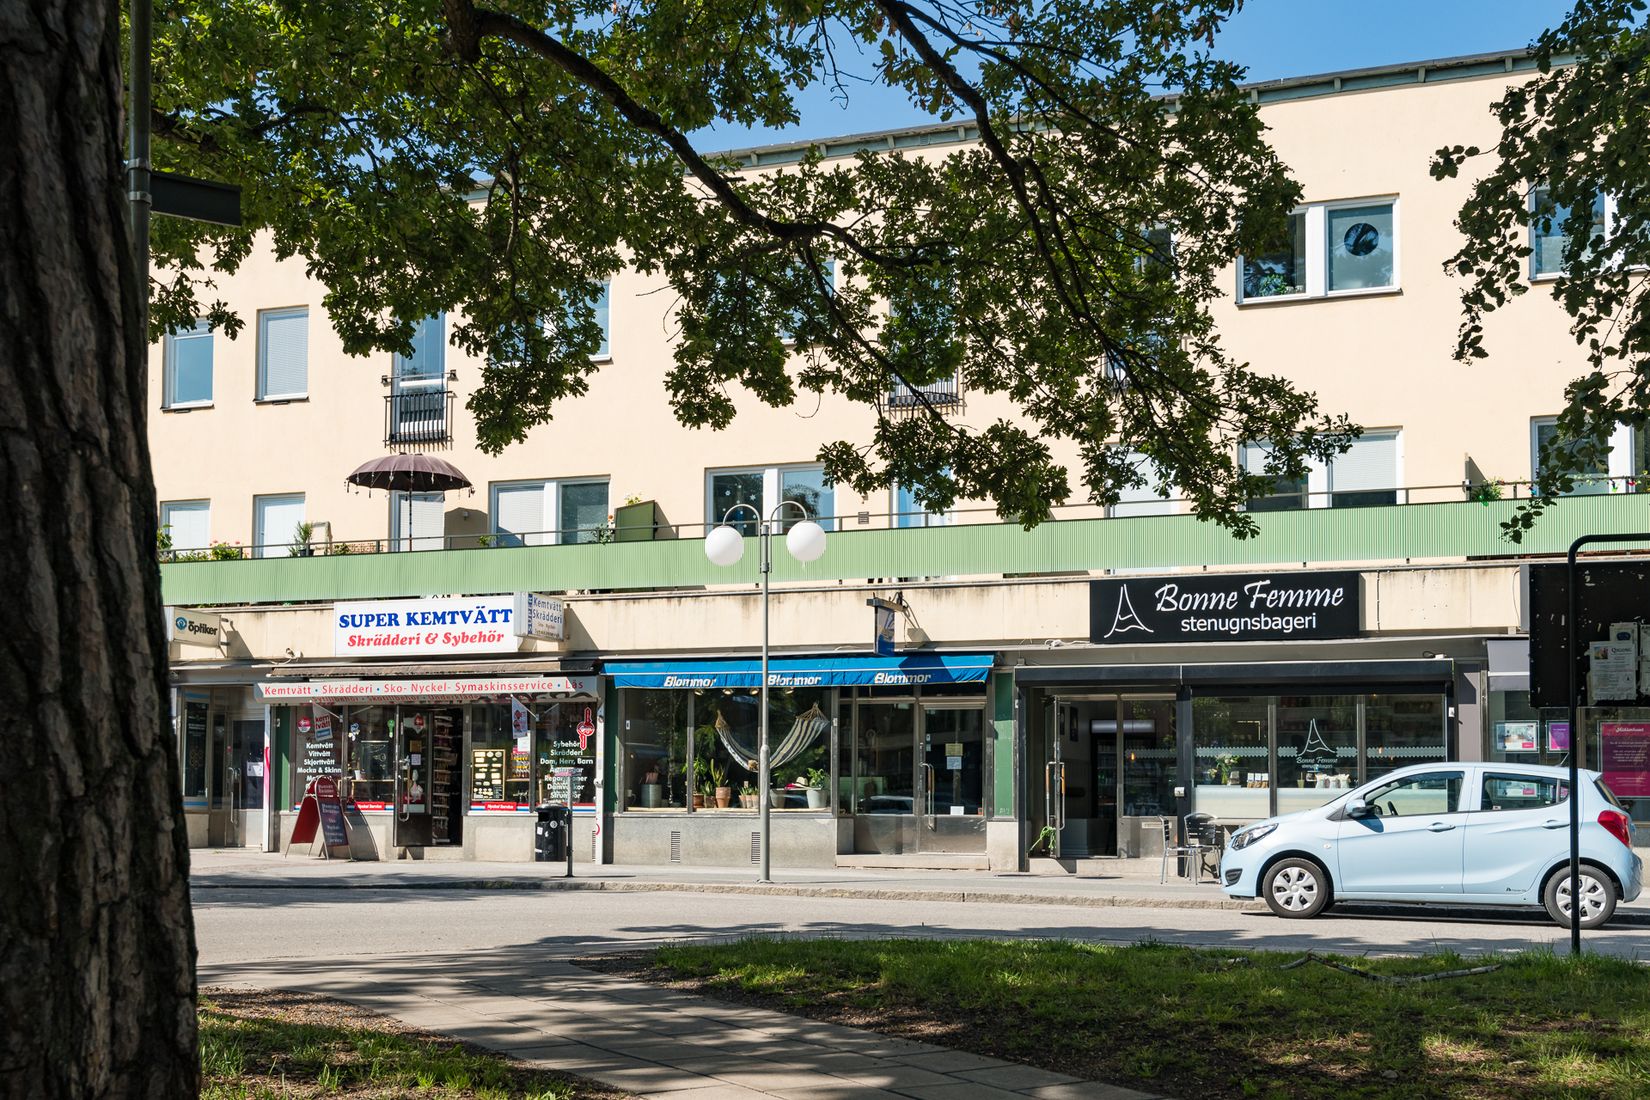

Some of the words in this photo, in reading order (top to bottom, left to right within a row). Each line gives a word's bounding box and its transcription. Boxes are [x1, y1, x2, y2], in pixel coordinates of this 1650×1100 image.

[1154, 583, 1240, 612] Bonne
[1243, 579, 1345, 609] Femme
[533, 596, 562, 612] Kemtvätt
[338, 612, 400, 628] SUPER
[405, 605, 513, 626] KEMTVÄTT
[532, 608, 563, 624] Skrädderi
[1180, 612, 1317, 634] stenugnsbageri
[347, 632, 421, 647] Skrädderi
[424, 632, 439, 645] &
[441, 630, 505, 647] Sybehör
[663, 675, 717, 687] Blommor
[767, 674, 822, 686] Blommor
[873, 672, 932, 684] Blommor
[264, 685, 312, 696] Kemtvätt
[321, 683, 373, 694] Skrädderi
[384, 683, 407, 693] Sko-
[411, 681, 451, 694] Nyckel-
[455, 680, 553, 694] Symaskinsservice
[553, 740, 581, 748] Sybehör
[550, 748, 583, 756] Skrädderi
[577, 757, 594, 765] Barn
[1295, 756, 1316, 764] Bonne
[1315, 756, 1338, 764] Femme
[296, 766, 317, 774] Mocka
[317, 766, 323, 774] &
[324, 766, 342, 774] Skinn
